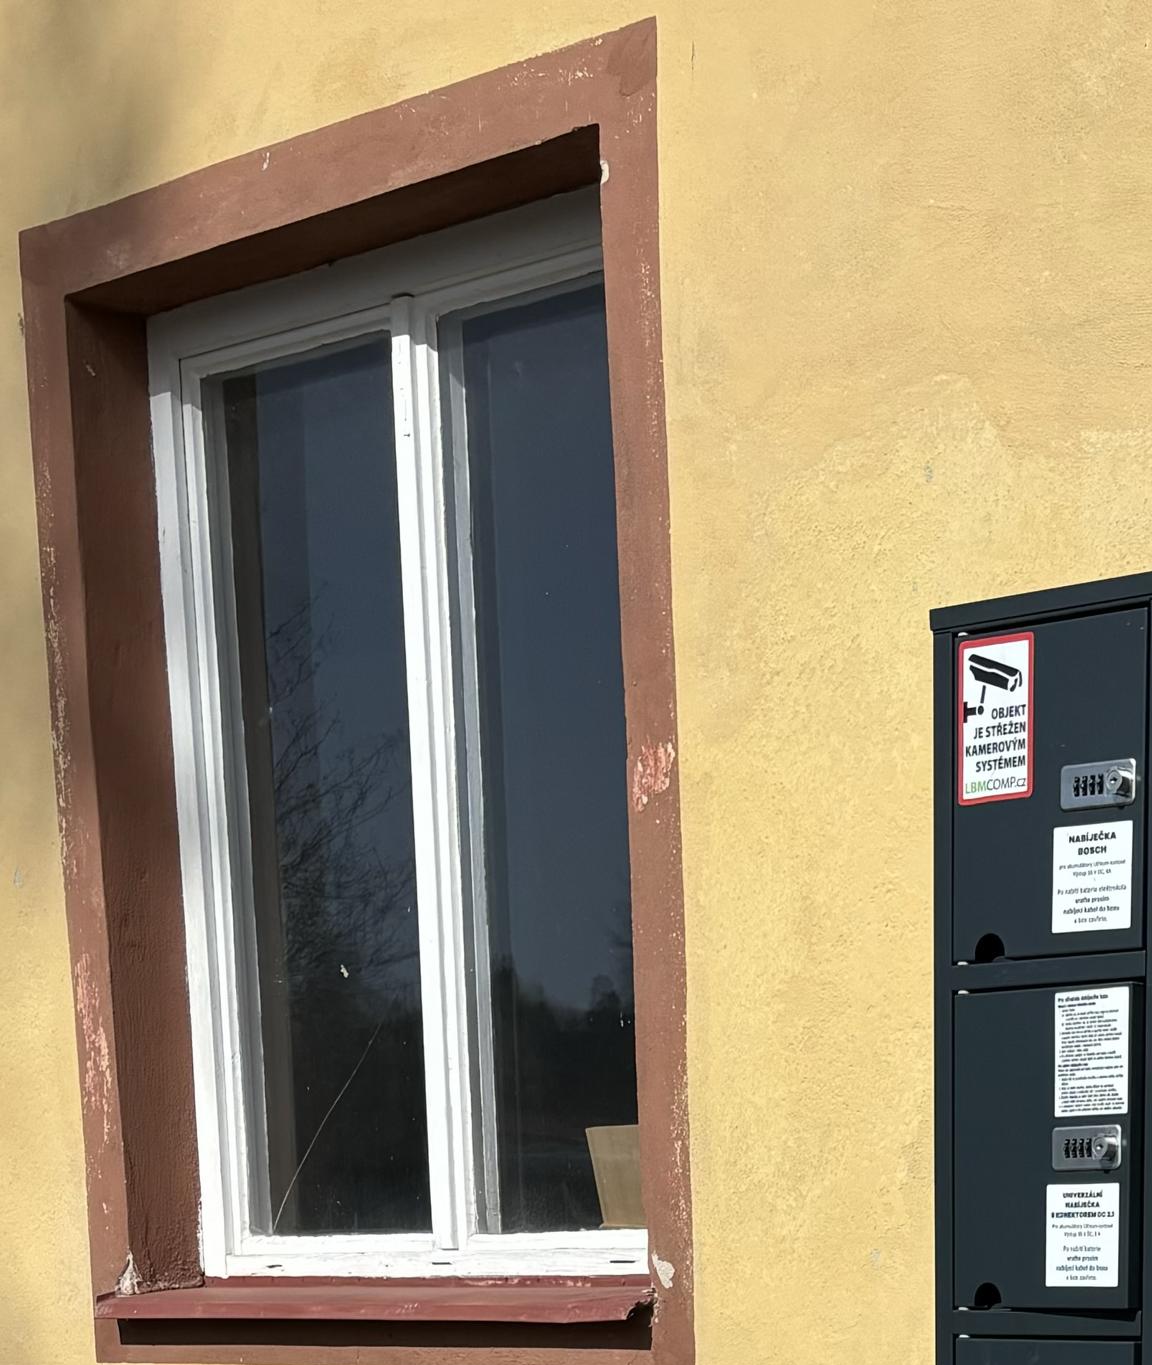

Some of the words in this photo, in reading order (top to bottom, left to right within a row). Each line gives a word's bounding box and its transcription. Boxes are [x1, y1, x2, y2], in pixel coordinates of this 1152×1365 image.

[991, 704, 1026, 720] OBJEKT
[973, 727, 984, 740] JE
[985, 720, 1026, 738] STŘEŽEN
[965, 737, 1026, 758] KAMEROVÝM
[975, 755, 1026, 773] SYSTÉMEM
[965, 776, 1026, 794] LBMCOMP.cz
[1068, 830, 1117, 844] NABÍJEČKA
[1077, 845, 1107, 856] BOSCH
